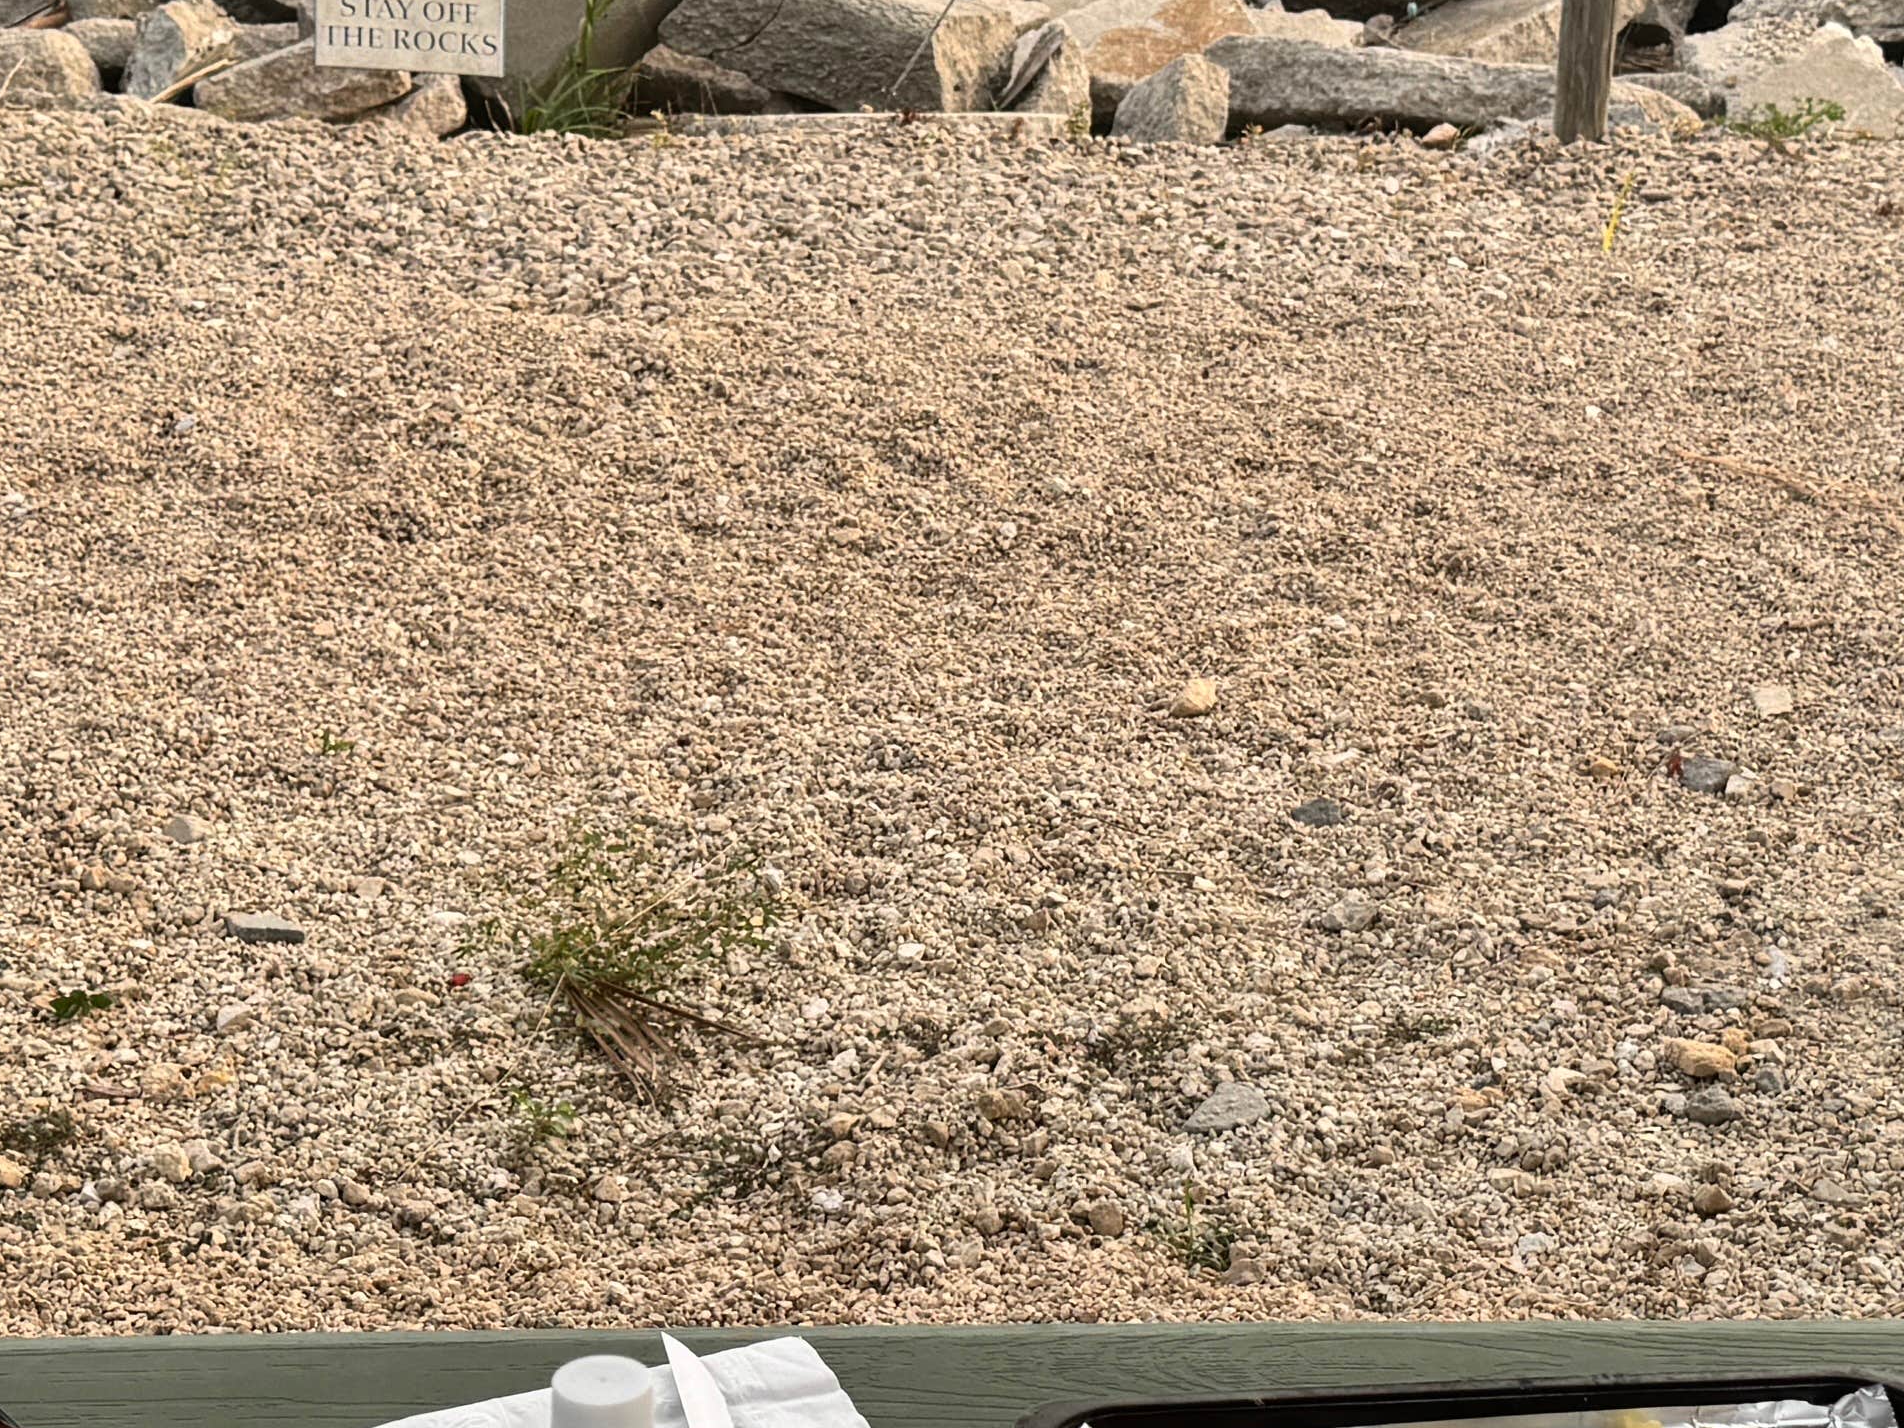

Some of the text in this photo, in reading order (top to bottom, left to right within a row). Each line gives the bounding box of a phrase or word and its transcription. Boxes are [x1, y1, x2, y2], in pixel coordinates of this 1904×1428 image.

[422, 0, 480, 25] OFF
[320, 25, 498, 56] THE ROCKS
